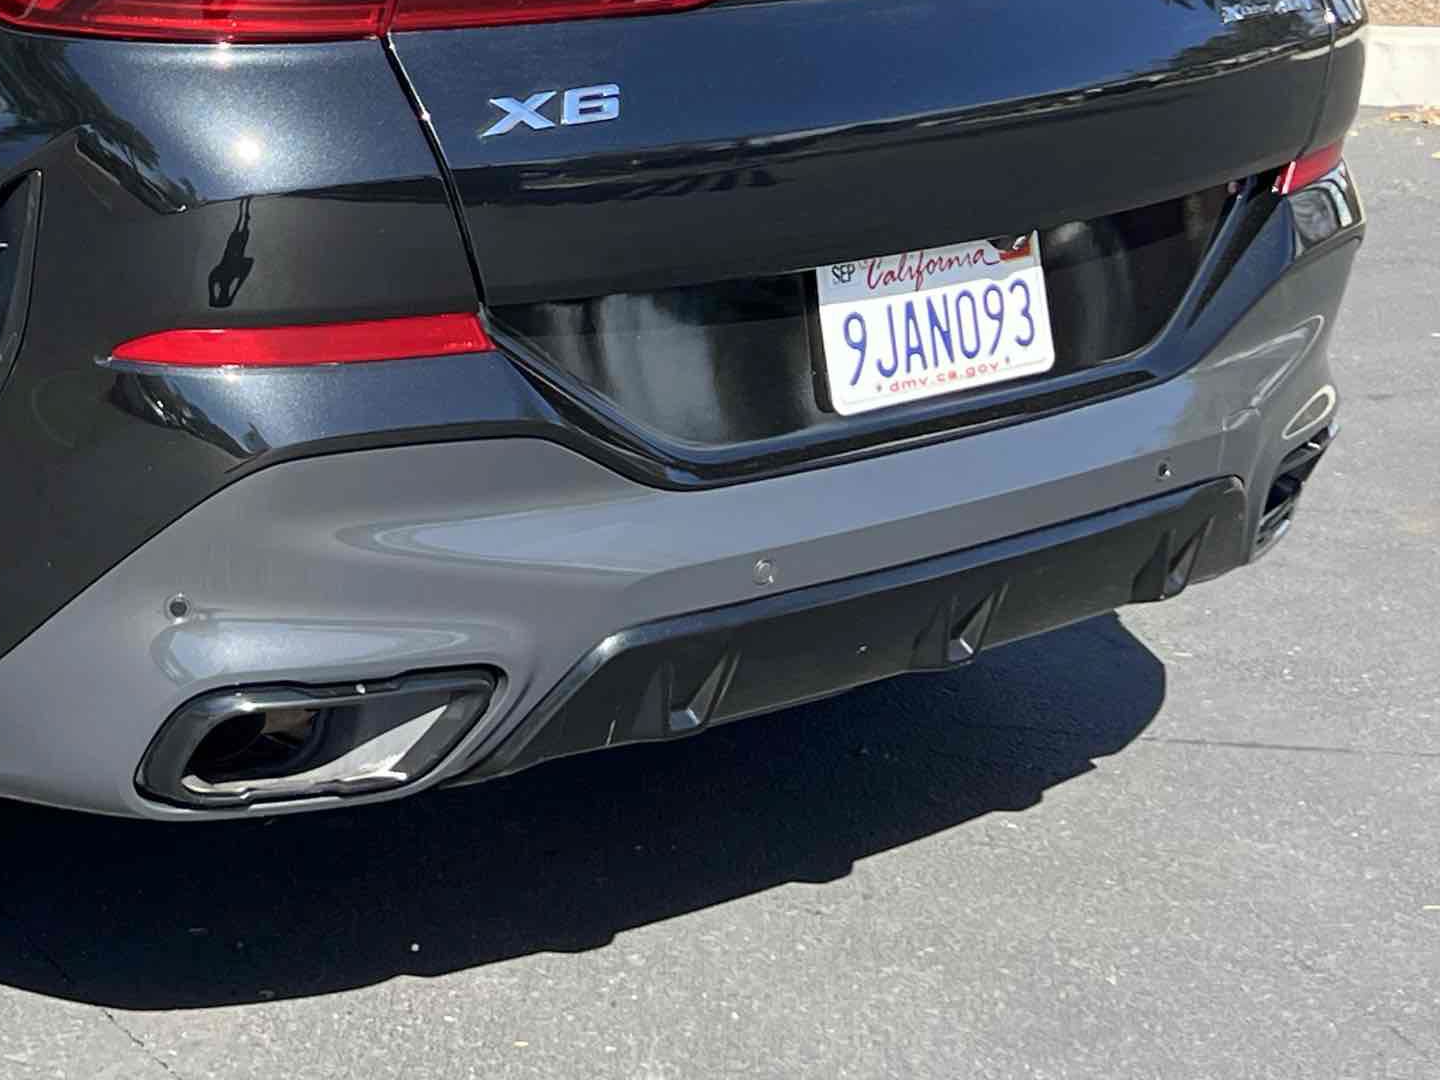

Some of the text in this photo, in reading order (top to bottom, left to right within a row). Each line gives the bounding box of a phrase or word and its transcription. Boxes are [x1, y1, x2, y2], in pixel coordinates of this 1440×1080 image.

[478, 82, 622, 138] X6
[831, 263, 856, 285] SEP
[866, 247, 1001, 292] California
[843, 278, 1036, 387] 9JAN093
